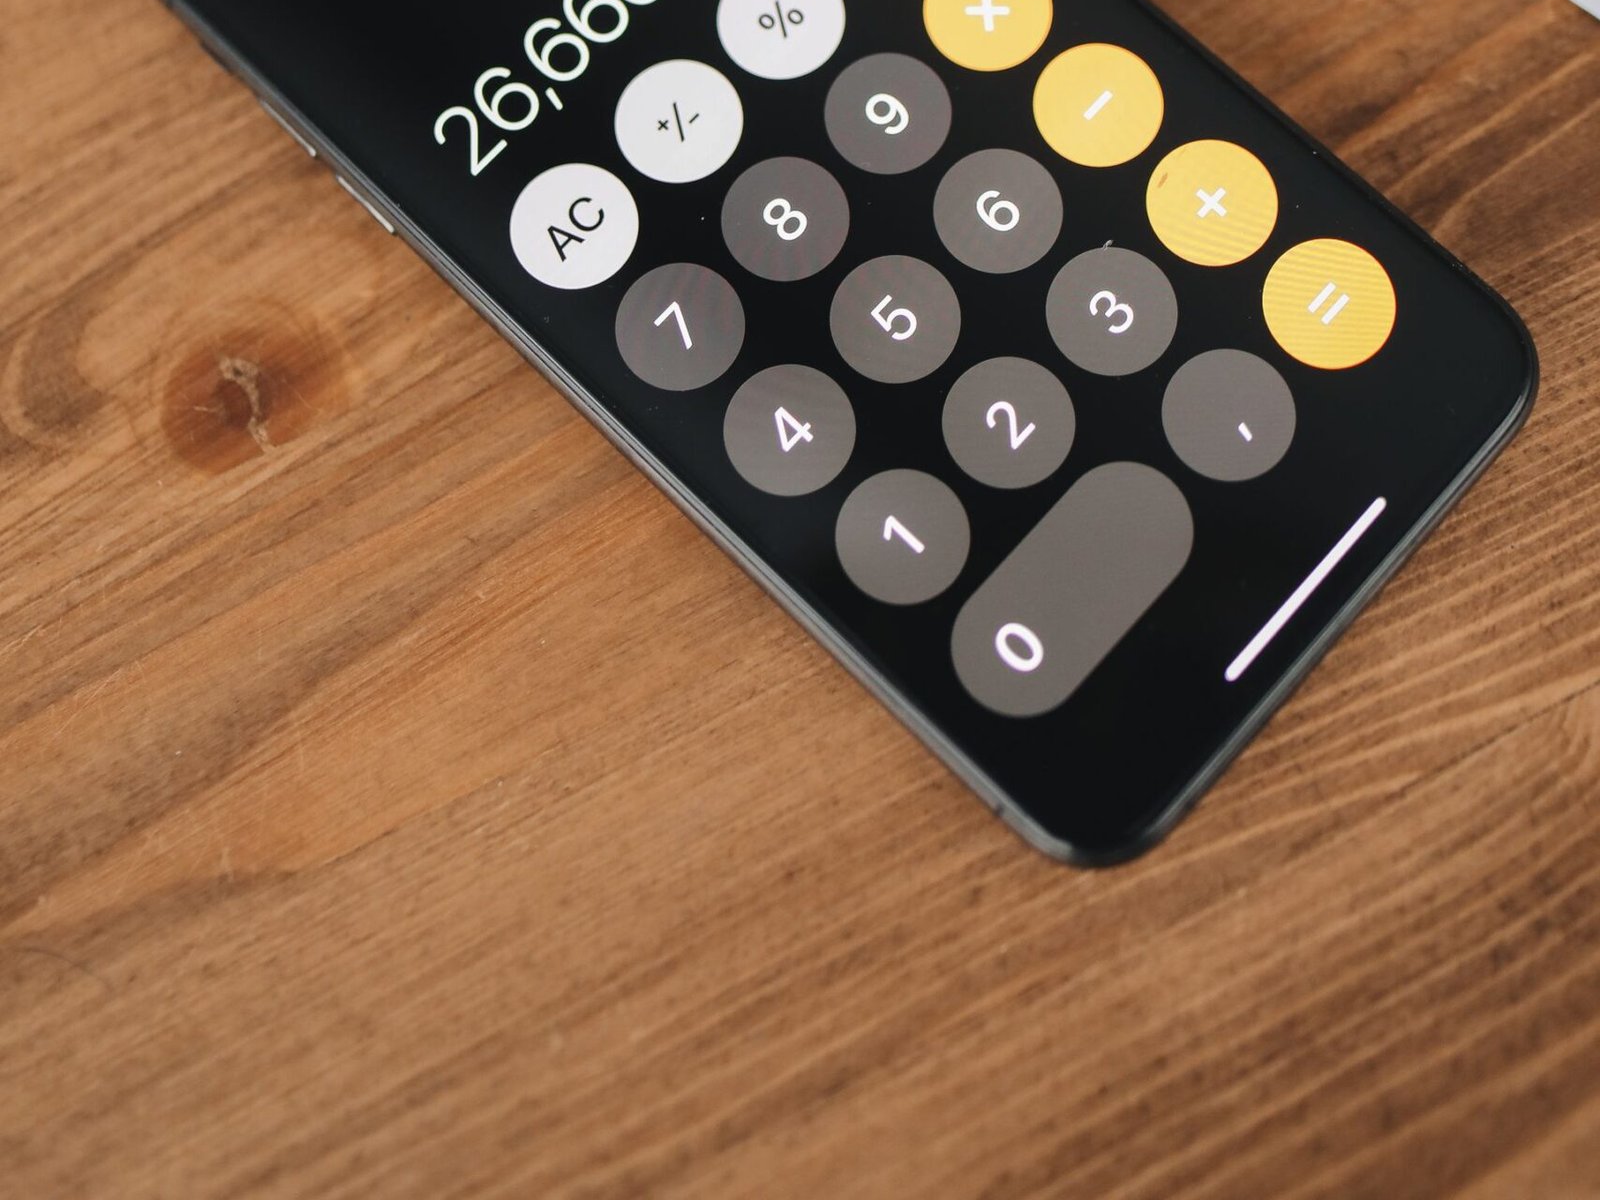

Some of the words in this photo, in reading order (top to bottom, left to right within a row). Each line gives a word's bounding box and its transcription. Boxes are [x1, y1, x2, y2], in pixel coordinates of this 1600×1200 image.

[547, 197, 605, 262] AC
[758, 1, 804, 38] %
[653, 301, 693, 350] 7
[762, 198, 808, 241] 8
[865, 93, 910, 135] 9
[774, 406, 814, 453] 4
[870, 294, 918, 341] 5
[976, 190, 1020, 232] 6
[882, 515, 925, 554] 1
[985, 400, 1036, 450] 2
[1089, 290, 1134, 334] 3
[995, 622, 1044, 672] 0
